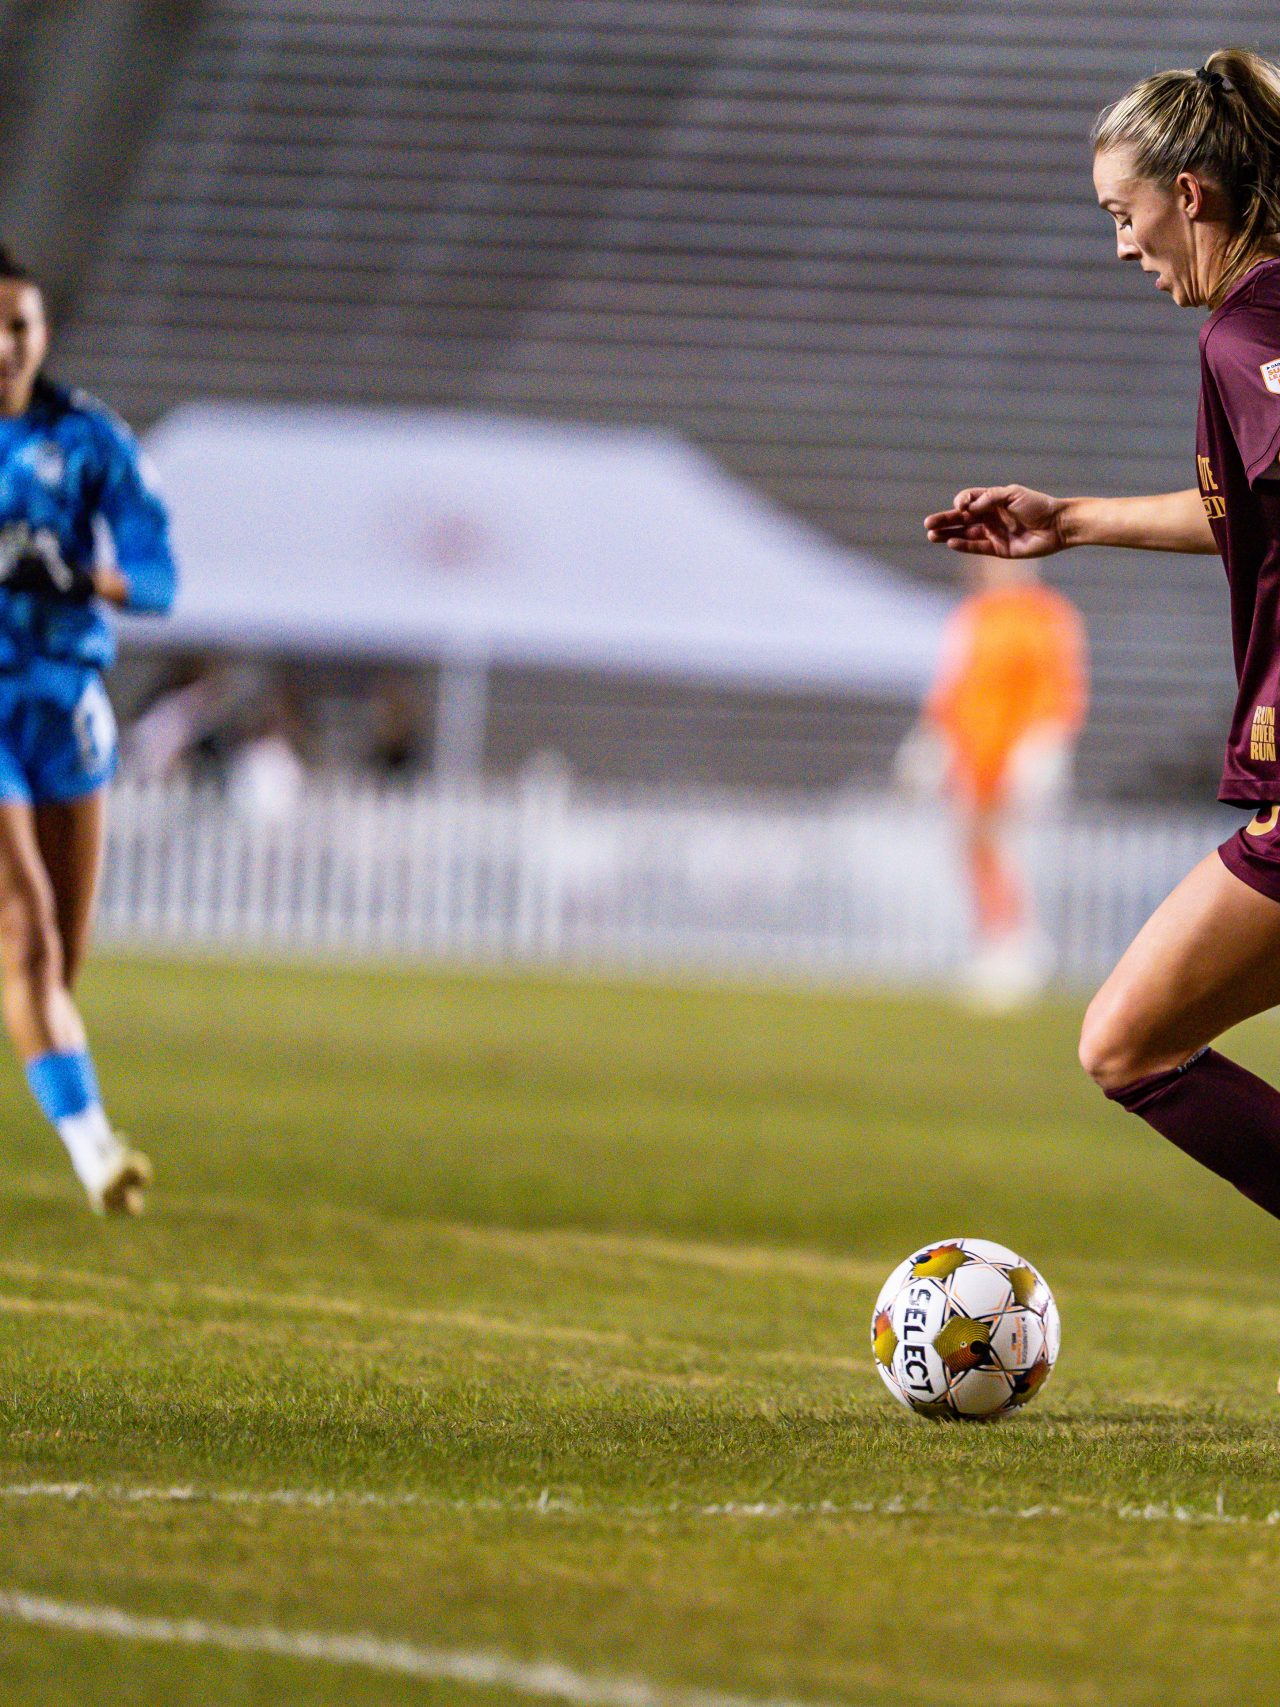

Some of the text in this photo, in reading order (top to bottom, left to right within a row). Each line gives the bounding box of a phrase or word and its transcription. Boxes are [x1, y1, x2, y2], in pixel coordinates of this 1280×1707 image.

[1253, 705, 1275, 726] RUN
[1251, 724, 1275, 744] RIVER
[1250, 742, 1276, 762] RUN
[904, 1288, 935, 1394] SELECT
